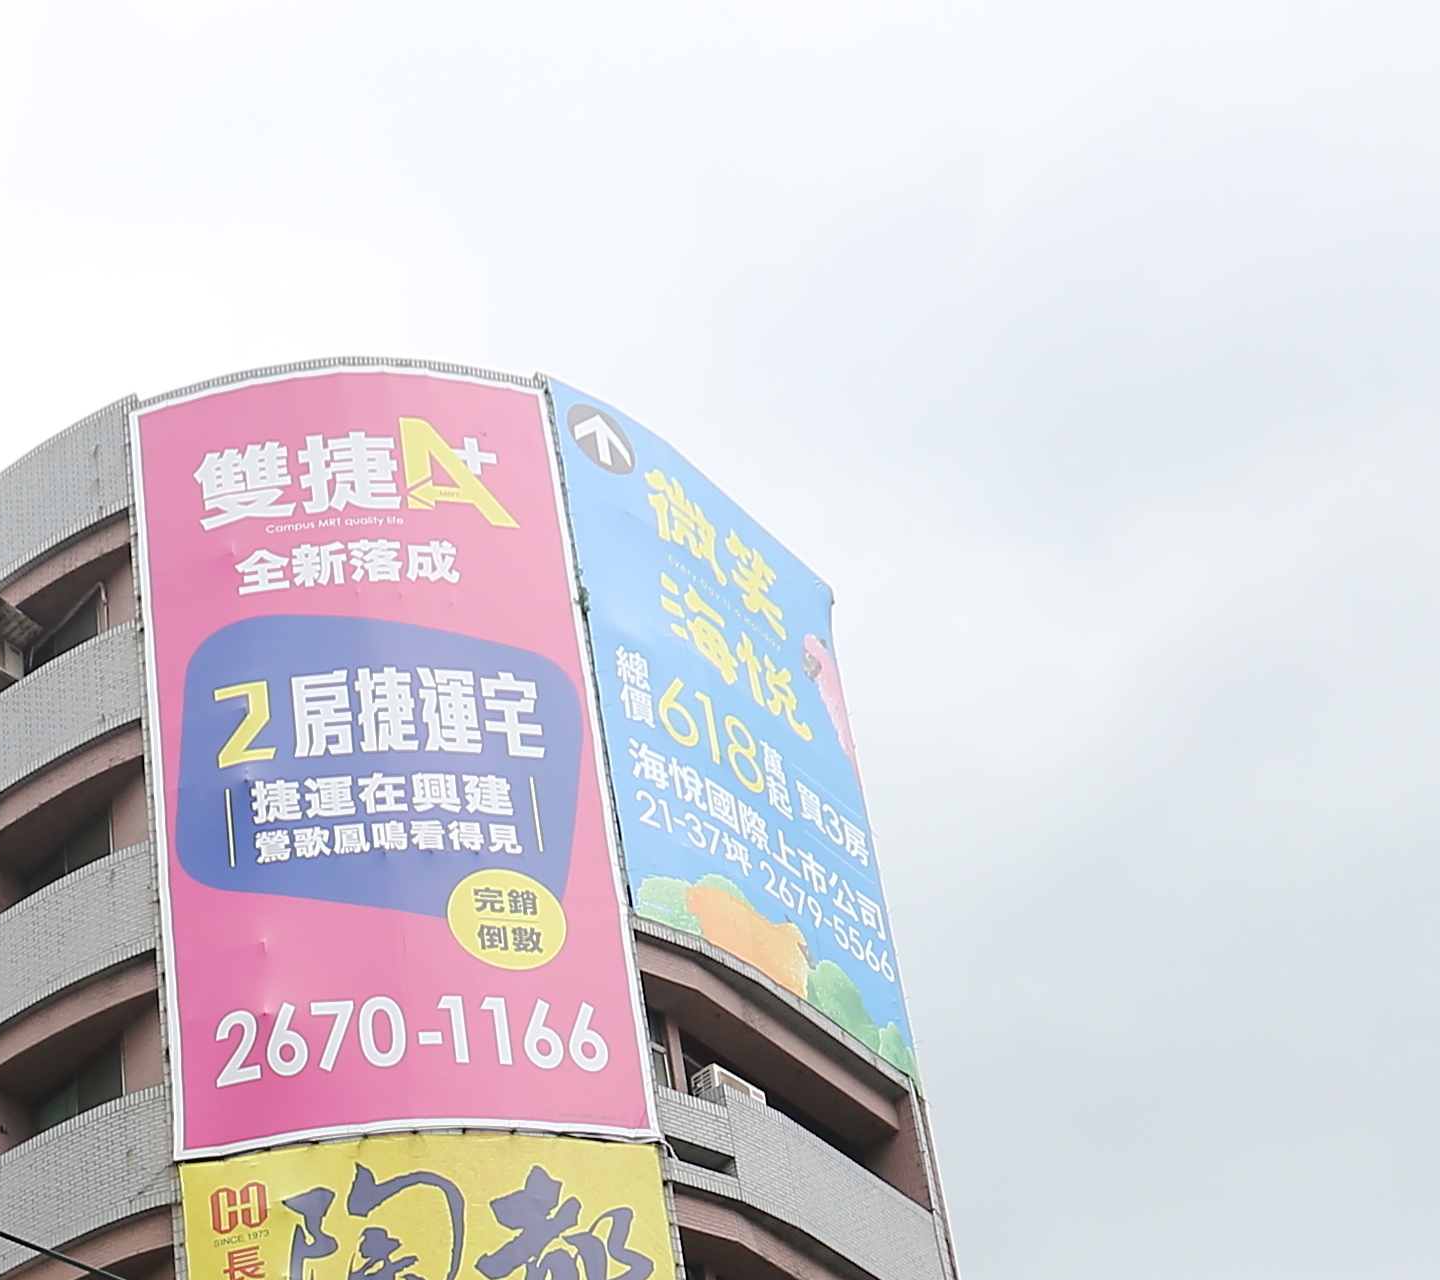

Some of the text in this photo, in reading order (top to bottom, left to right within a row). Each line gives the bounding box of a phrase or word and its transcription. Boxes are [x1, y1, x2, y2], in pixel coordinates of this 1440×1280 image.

[265, 514, 405, 534] Campus MRT quality life
[234, 539, 462, 596] 全新落成
[644, 468, 788, 641] 微笑
[660, 571, 814, 743] 海悅
[615, 644, 657, 729] 總價
[657, 677, 765, 794] 618
[251, 773, 514, 824] 捷運在興建
[254, 819, 524, 865] 鶯歌鳳鳴看得見
[473, 886, 540, 918] 完銷
[634, 790, 896, 984] 21-37坪 2679-5566
[476, 922, 545, 958] 倒數
[214, 994, 610, 1089] 2670-1166
[212, 1229, 272, 1249] SINCE 1973
